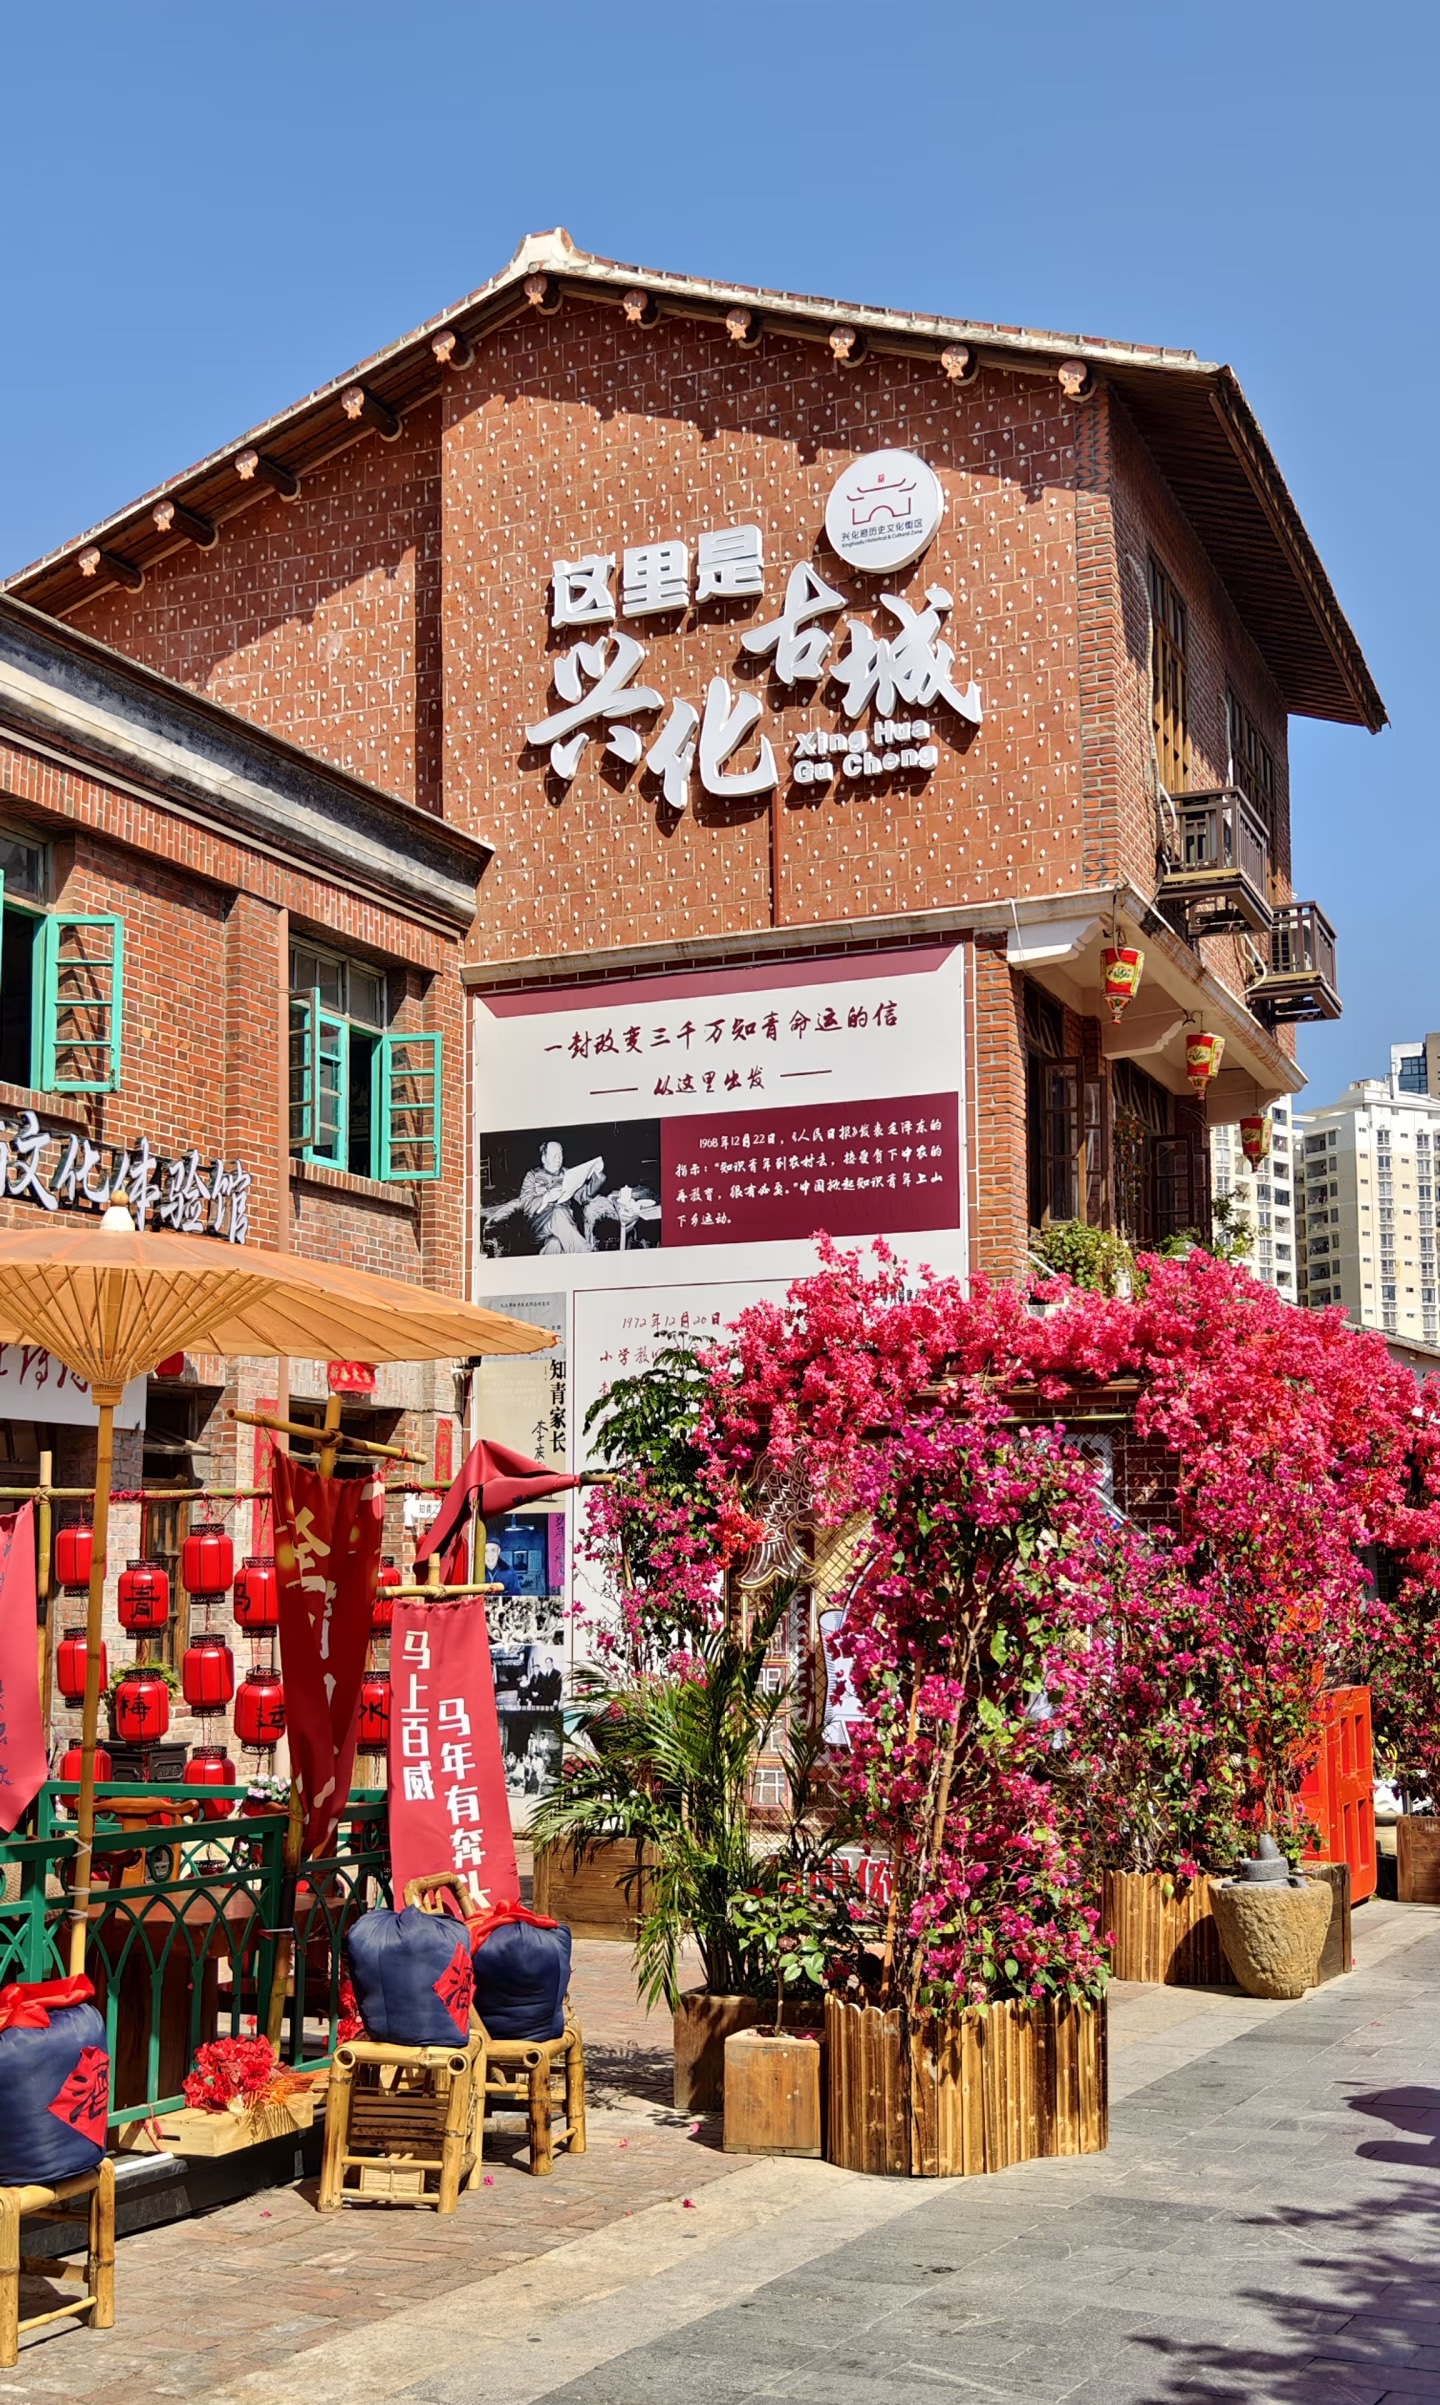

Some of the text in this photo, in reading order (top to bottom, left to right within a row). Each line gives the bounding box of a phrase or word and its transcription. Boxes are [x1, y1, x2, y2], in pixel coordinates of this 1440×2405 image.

[552, 524, 764, 629] 这里是
[740, 561, 984, 725] 古城
[525, 632, 778, 810] 兴化
[794, 719, 931, 759] Xing Hua
[793, 745, 938, 785] Gu Cheng
[543, 1001, 899, 1060] 一封改变三千万知青命运的信
[0, 1110, 252, 1245] 文化体验馆
[677, 1211, 733, 1228] 下乡运动。
[622, 1311, 721, 1330] 1972年12月20日
[549, 1358, 567, 1454] 知青家长
[124, 1584, 161, 1620] 青
[400, 1630, 435, 1801] 马上百威
